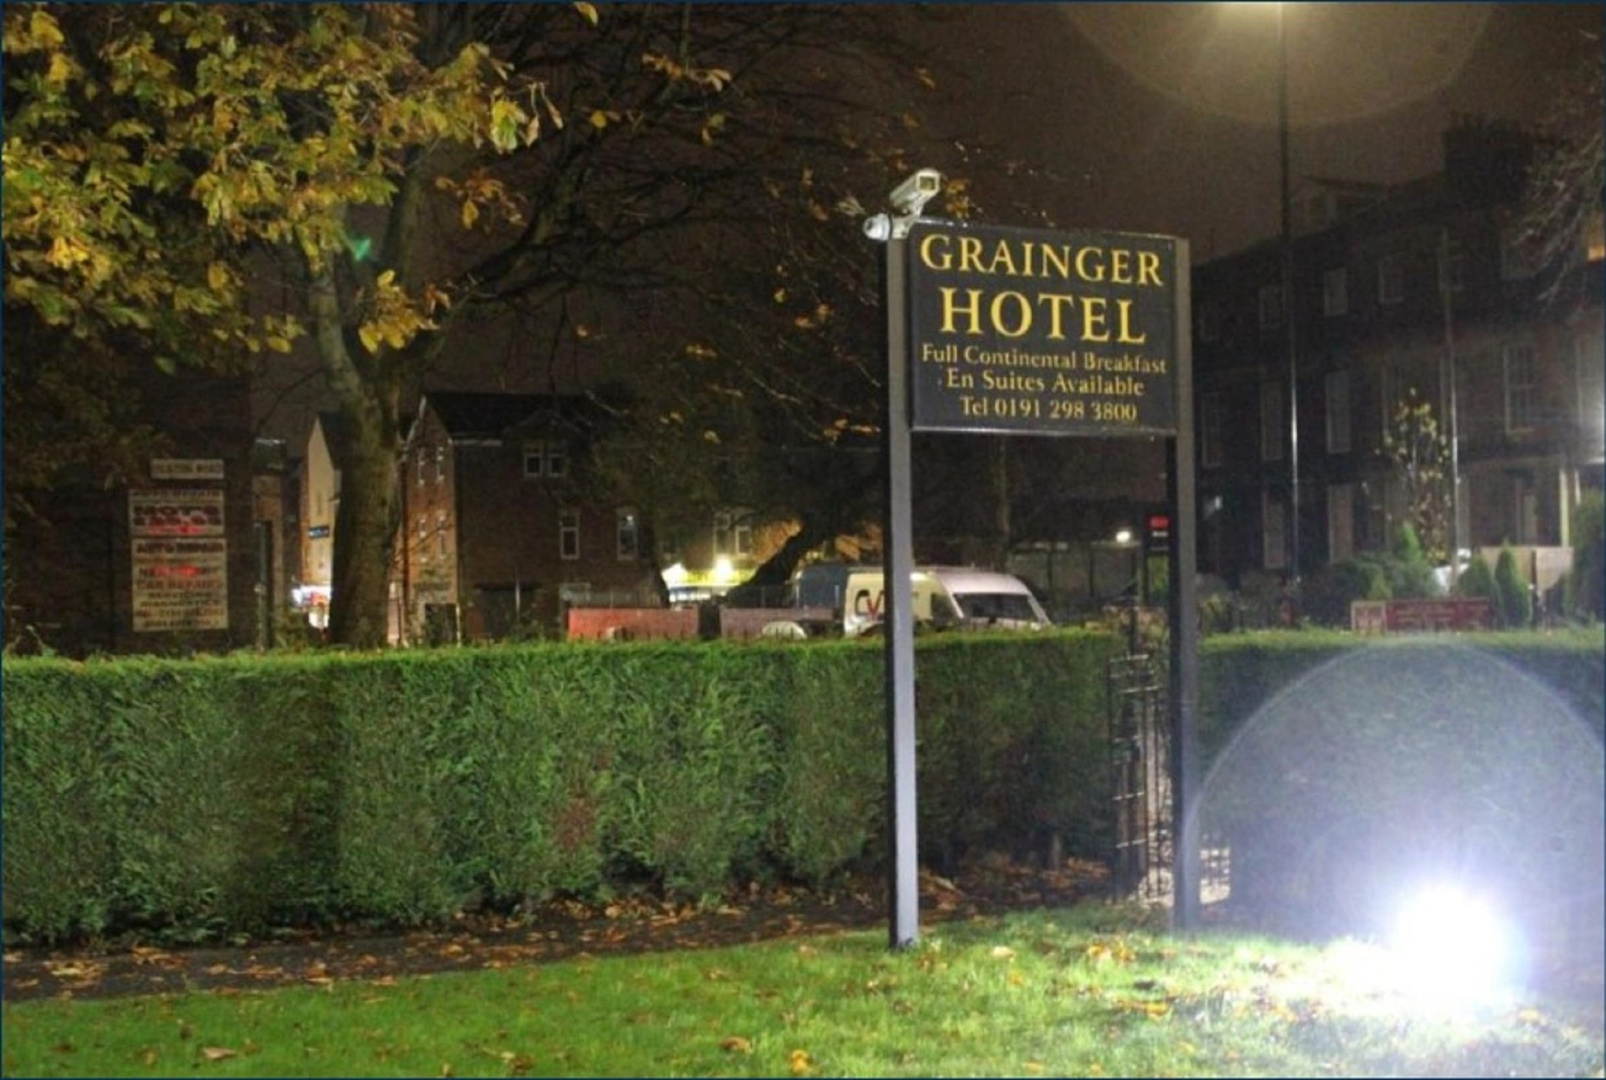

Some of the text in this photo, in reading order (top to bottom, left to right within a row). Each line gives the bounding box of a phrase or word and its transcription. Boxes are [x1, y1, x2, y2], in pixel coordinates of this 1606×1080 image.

[920, 233, 1164, 287] GRAINGER
[938, 286, 1147, 345] HOTEL
[921, 343, 1167, 374] Full Continental Breakfast
[946, 368, 1145, 396] En Suites Available
[960, 396, 1137, 421] Tel 0191 298 3800
